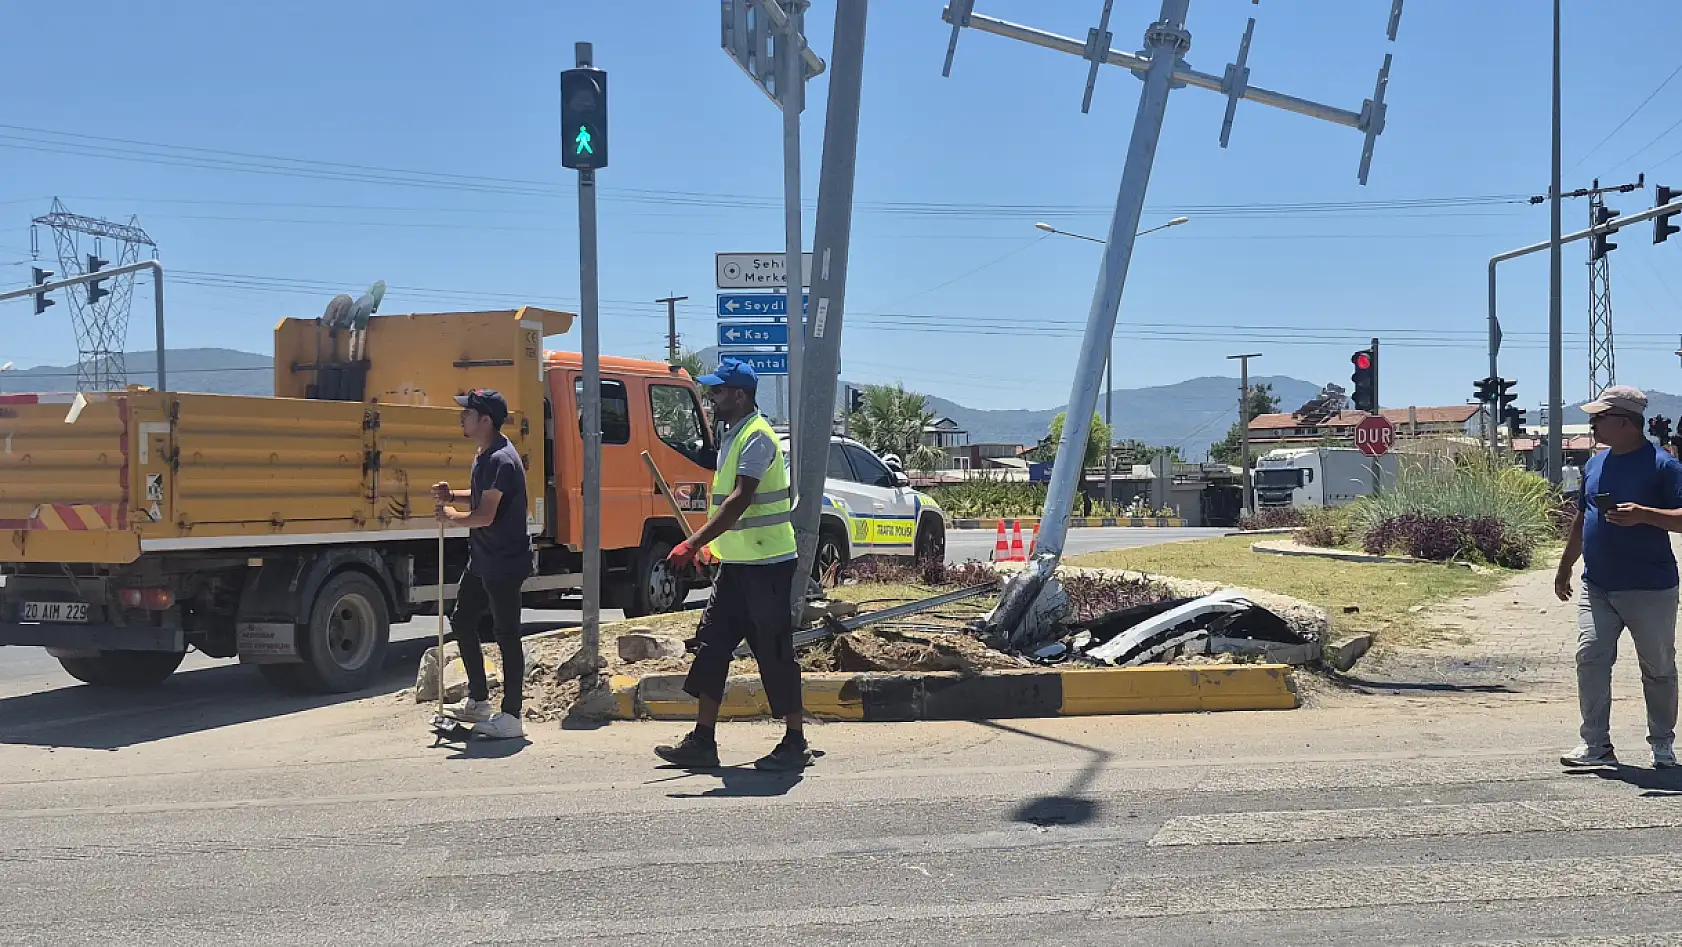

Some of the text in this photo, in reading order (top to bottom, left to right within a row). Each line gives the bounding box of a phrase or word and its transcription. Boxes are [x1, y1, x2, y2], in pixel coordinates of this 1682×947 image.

[753, 259, 785, 270] Şehi
[745, 273, 788, 283] Merke
[744, 301, 786, 312] Seydi
[744, 330, 770, 341] Kaş
[747, 359, 786, 368] Antal
[1358, 427, 1390, 445] DUR
[25, 603, 38, 619] 20
[66, 604, 87, 620] 229
